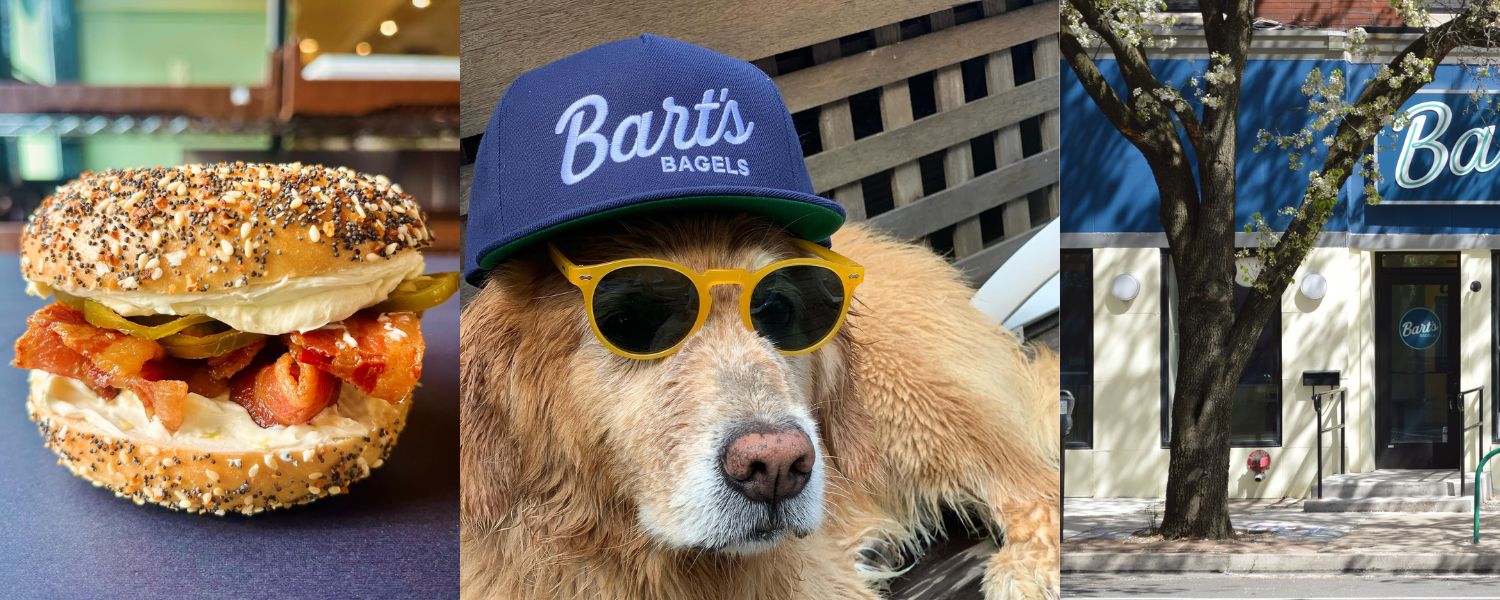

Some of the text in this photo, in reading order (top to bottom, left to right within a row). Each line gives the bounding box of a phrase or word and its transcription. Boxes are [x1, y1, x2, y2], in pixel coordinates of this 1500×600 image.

[555, 88, 754, 185] Bart's
[660, 156, 750, 176] BAGELS
[1402, 321, 1439, 337] Bart's
